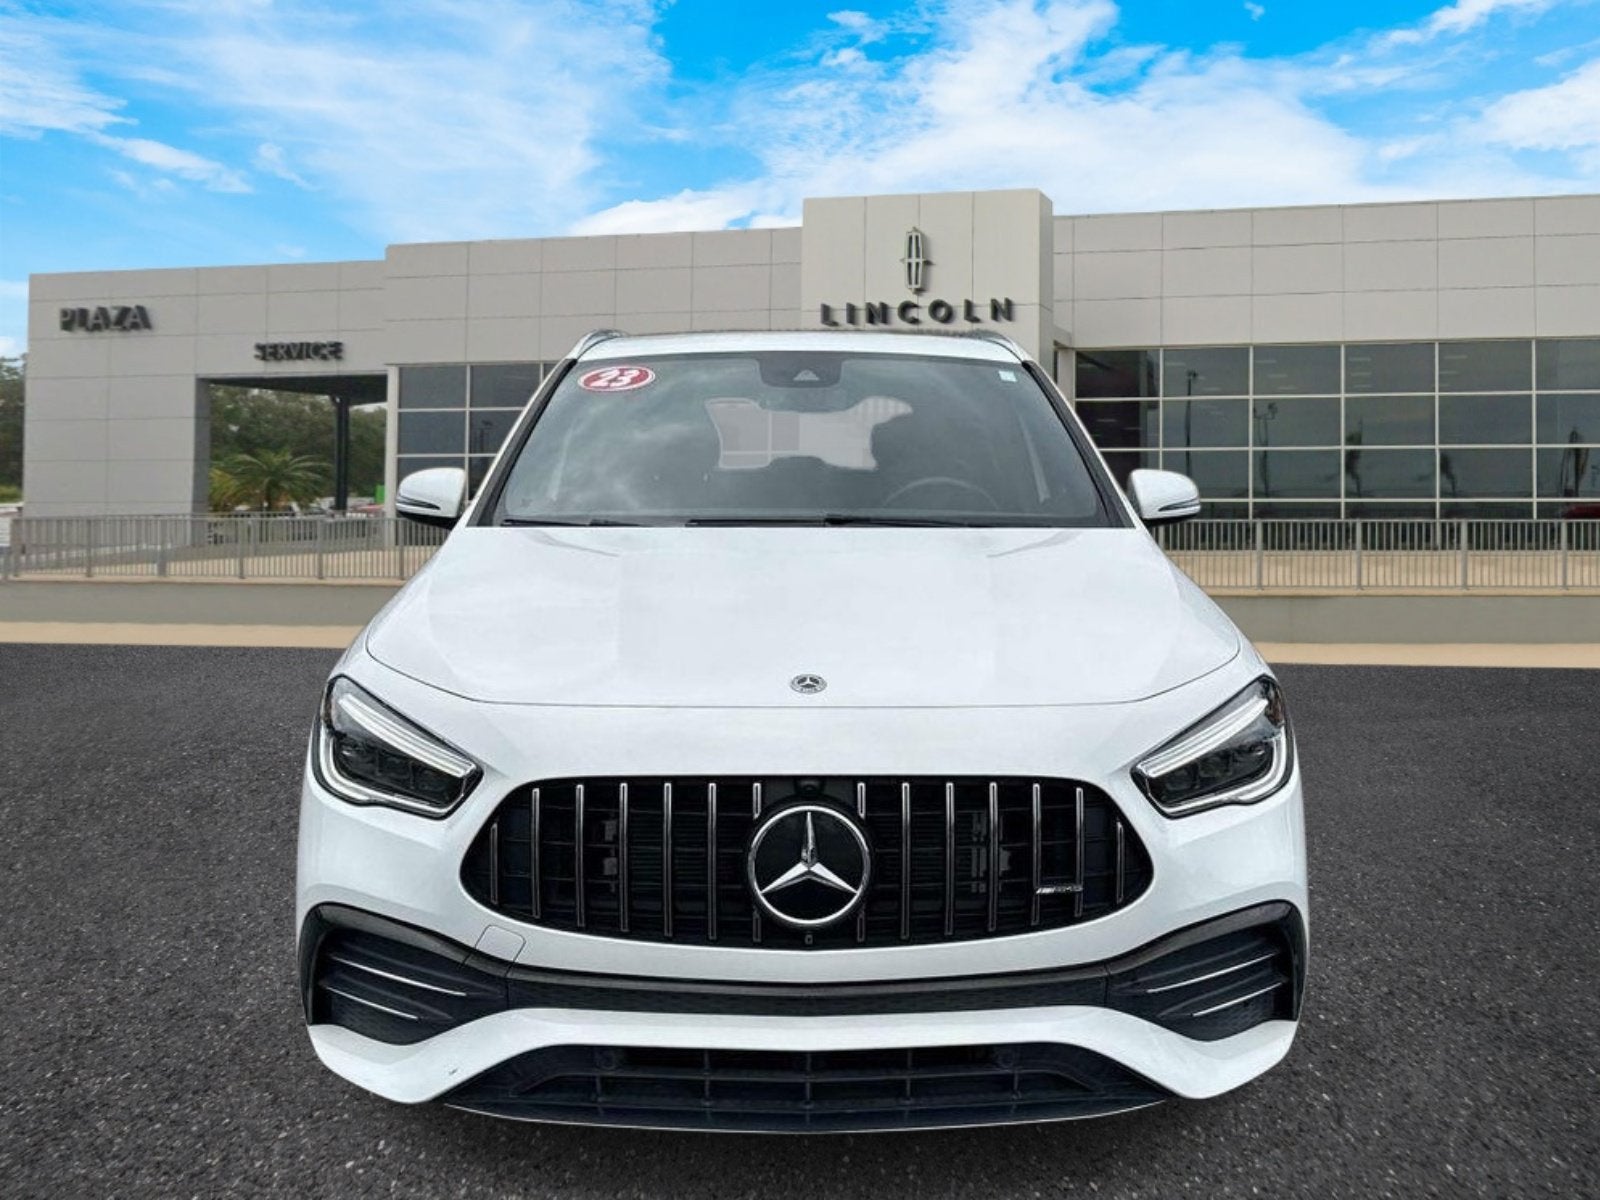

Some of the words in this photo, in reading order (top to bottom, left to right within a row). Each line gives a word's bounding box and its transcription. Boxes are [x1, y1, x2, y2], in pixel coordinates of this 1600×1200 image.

[60, 304, 152, 332] PLAZA
[820, 297, 1014, 327] LINCOLN
[254, 341, 343, 361] SERVICE
[589, 367, 642, 388] 23
